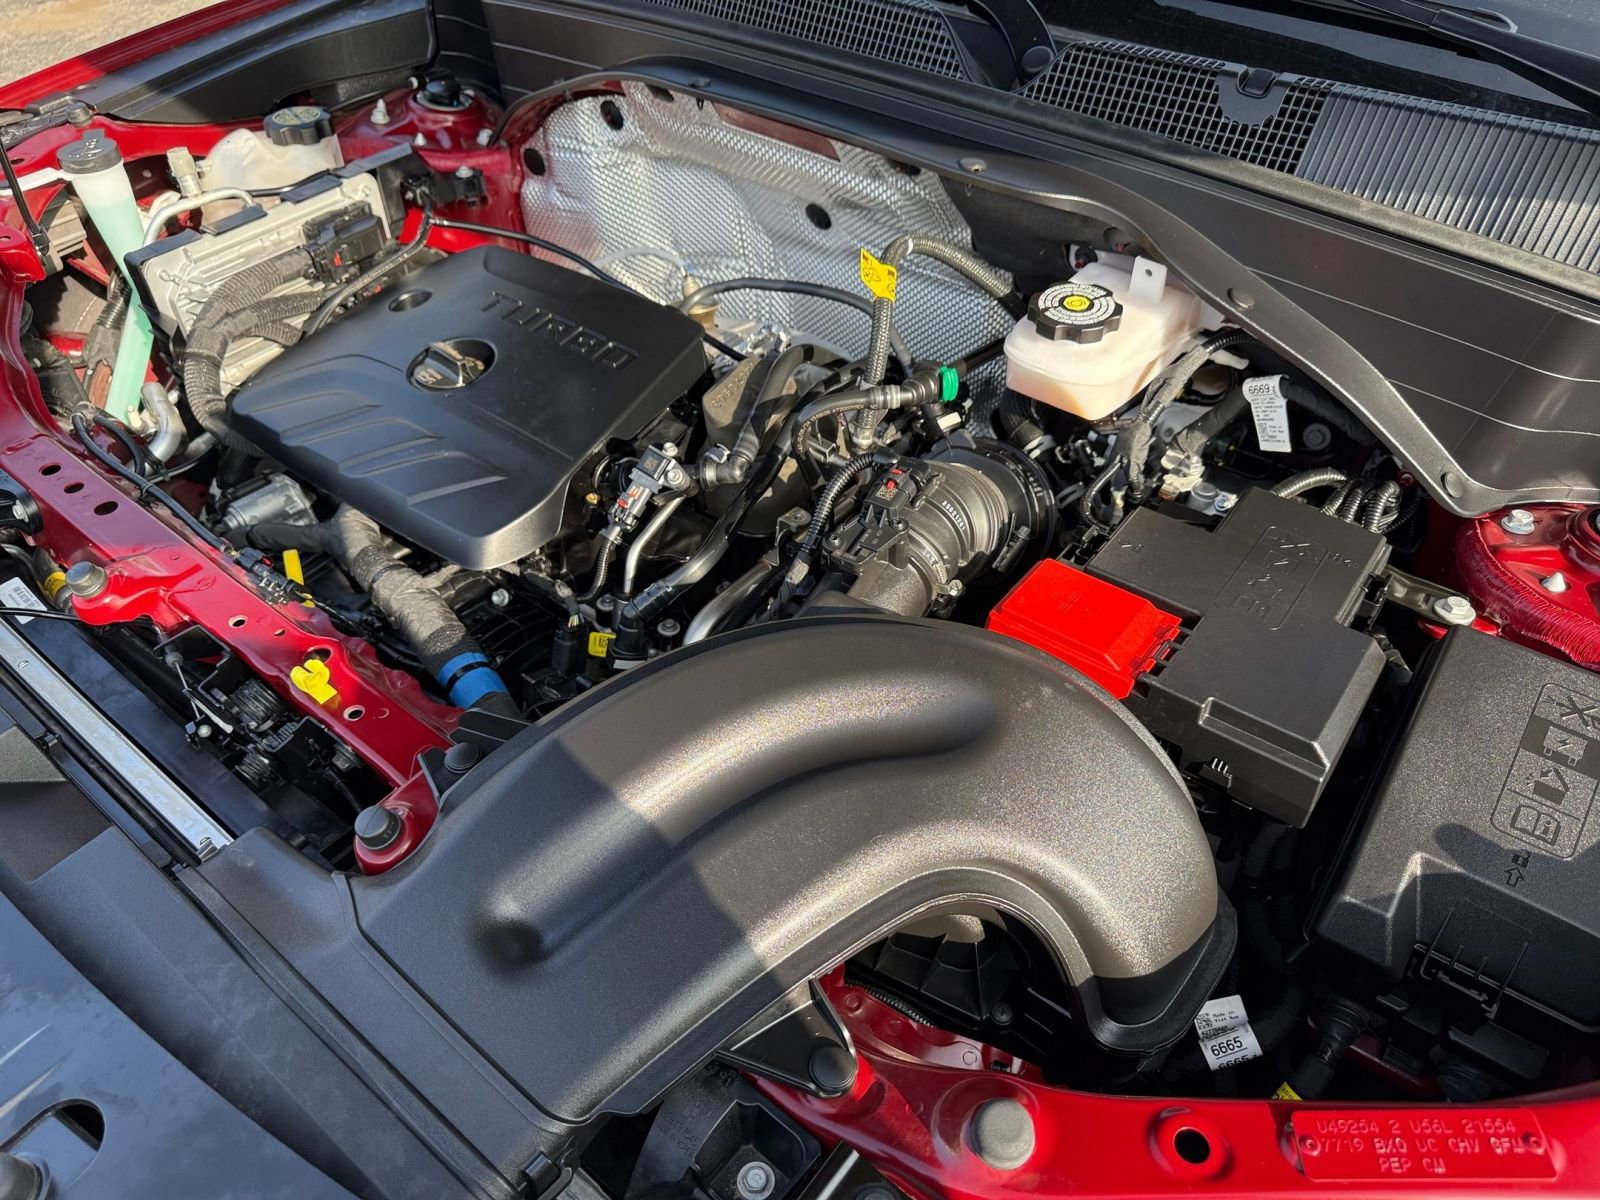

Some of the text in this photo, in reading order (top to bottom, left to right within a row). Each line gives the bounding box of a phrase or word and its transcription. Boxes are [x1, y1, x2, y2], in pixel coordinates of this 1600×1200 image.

[481, 291, 639, 368] TURBO
[1248, 384, 1270, 395] 6669
[1210, 1035, 1243, 1057] 6665
[1388, 1119, 1402, 1134] 2
[1379, 1156, 1412, 1174] PEP
